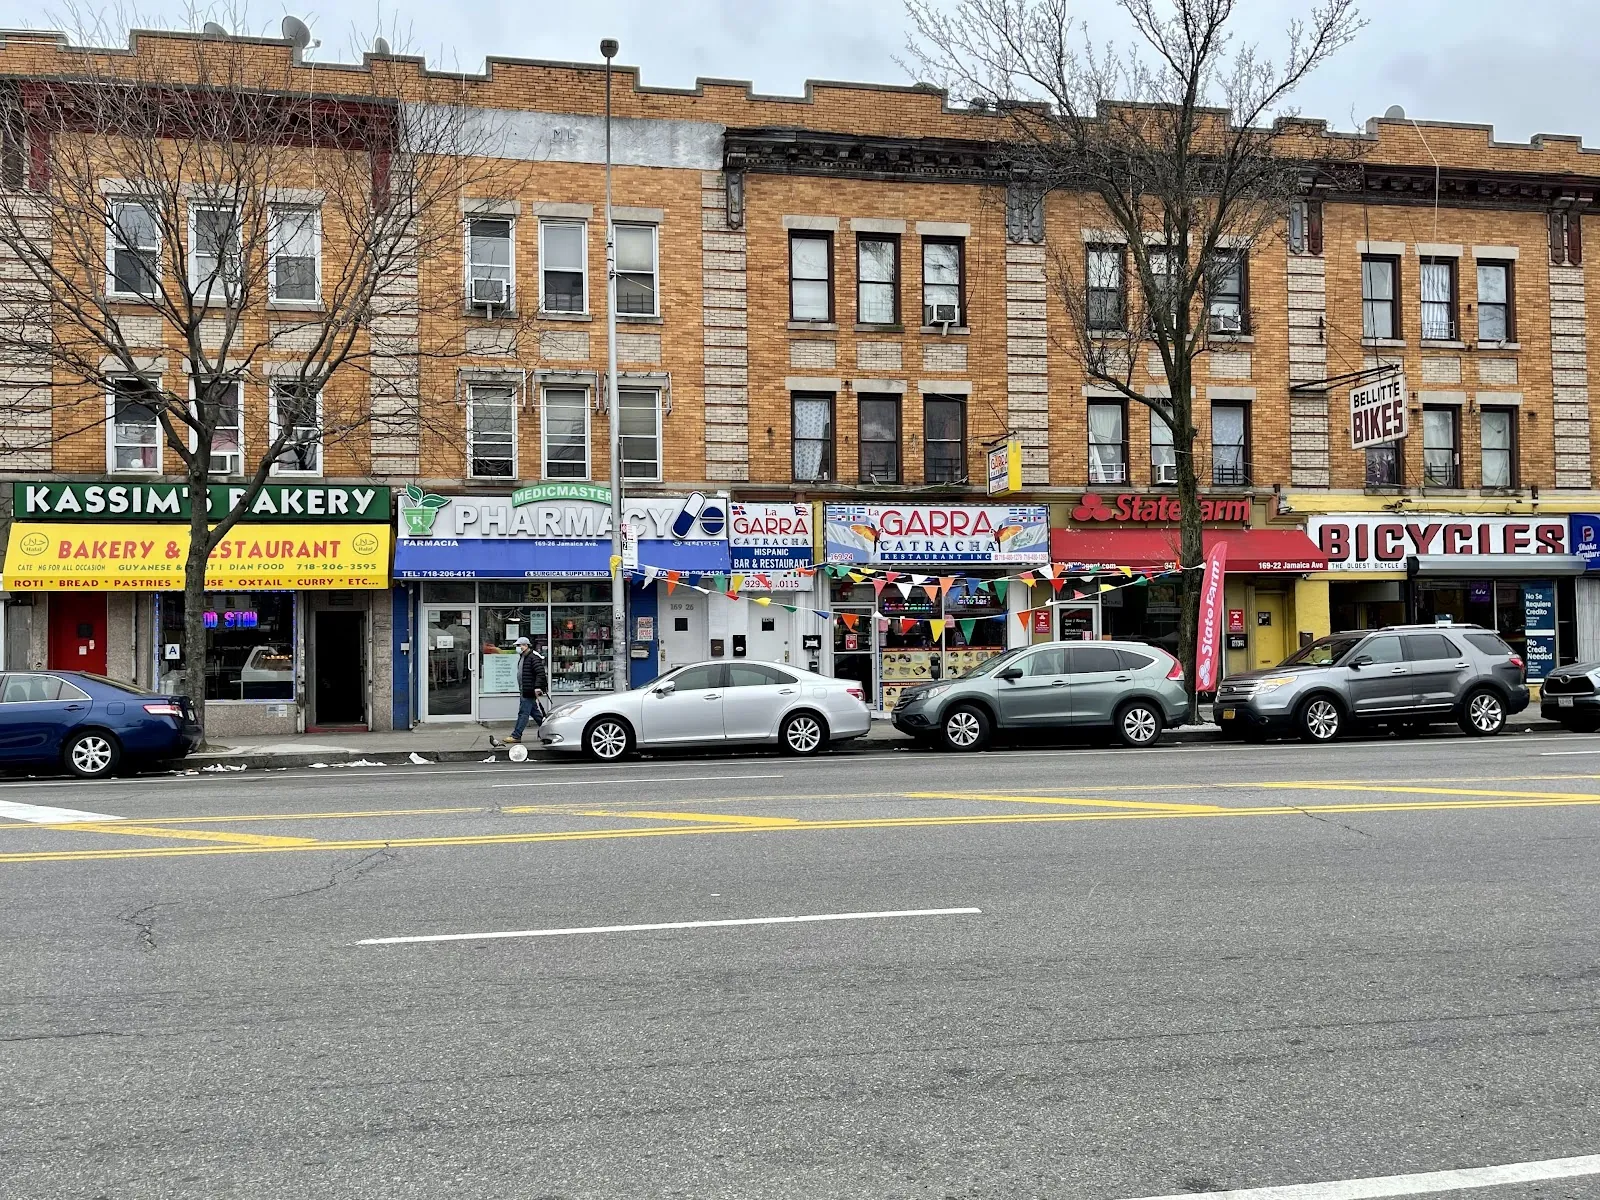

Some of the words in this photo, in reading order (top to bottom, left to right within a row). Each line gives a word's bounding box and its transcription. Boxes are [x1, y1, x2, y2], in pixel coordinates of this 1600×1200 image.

[1353, 381, 1400, 408] BELLITTE
[1352, 400, 1404, 444] BIKES
[26, 485, 213, 513] KASSIM'
[514, 486, 612, 504] MEDICMASTER
[765, 508, 777, 516] La
[454, 505, 675, 537] PHARMACY
[733, 517, 809, 535] GARRA
[868, 508, 880, 516] La
[879, 509, 994, 537] GARRA
[733, 538, 809, 546] CATRACHA
[880, 540, 997, 551] CATRACHA
[1319, 524, 1565, 562] BICYCLES
[58, 540, 155, 559] BAKERY
[165, 540, 181, 559] &
[754, 548, 789, 556] HISPANIC
[734, 559, 750, 568] BAR
[752, 559, 758, 568] &
[760, 559, 809, 569] RESTAURANT
[1258, 561, 1282, 569] 169-22
[1283, 561, 1310, 569] Jamaica
[1311, 561, 1324, 569] Ave
[59, 579, 99, 587] BREAD
[114, 579, 172, 587] PASTRIES
[238, 578, 283, 586] OXTAIL
[297, 578, 335, 586] CURRY
[1527, 638, 1537, 646] No
[168, 645, 178, 655] A
